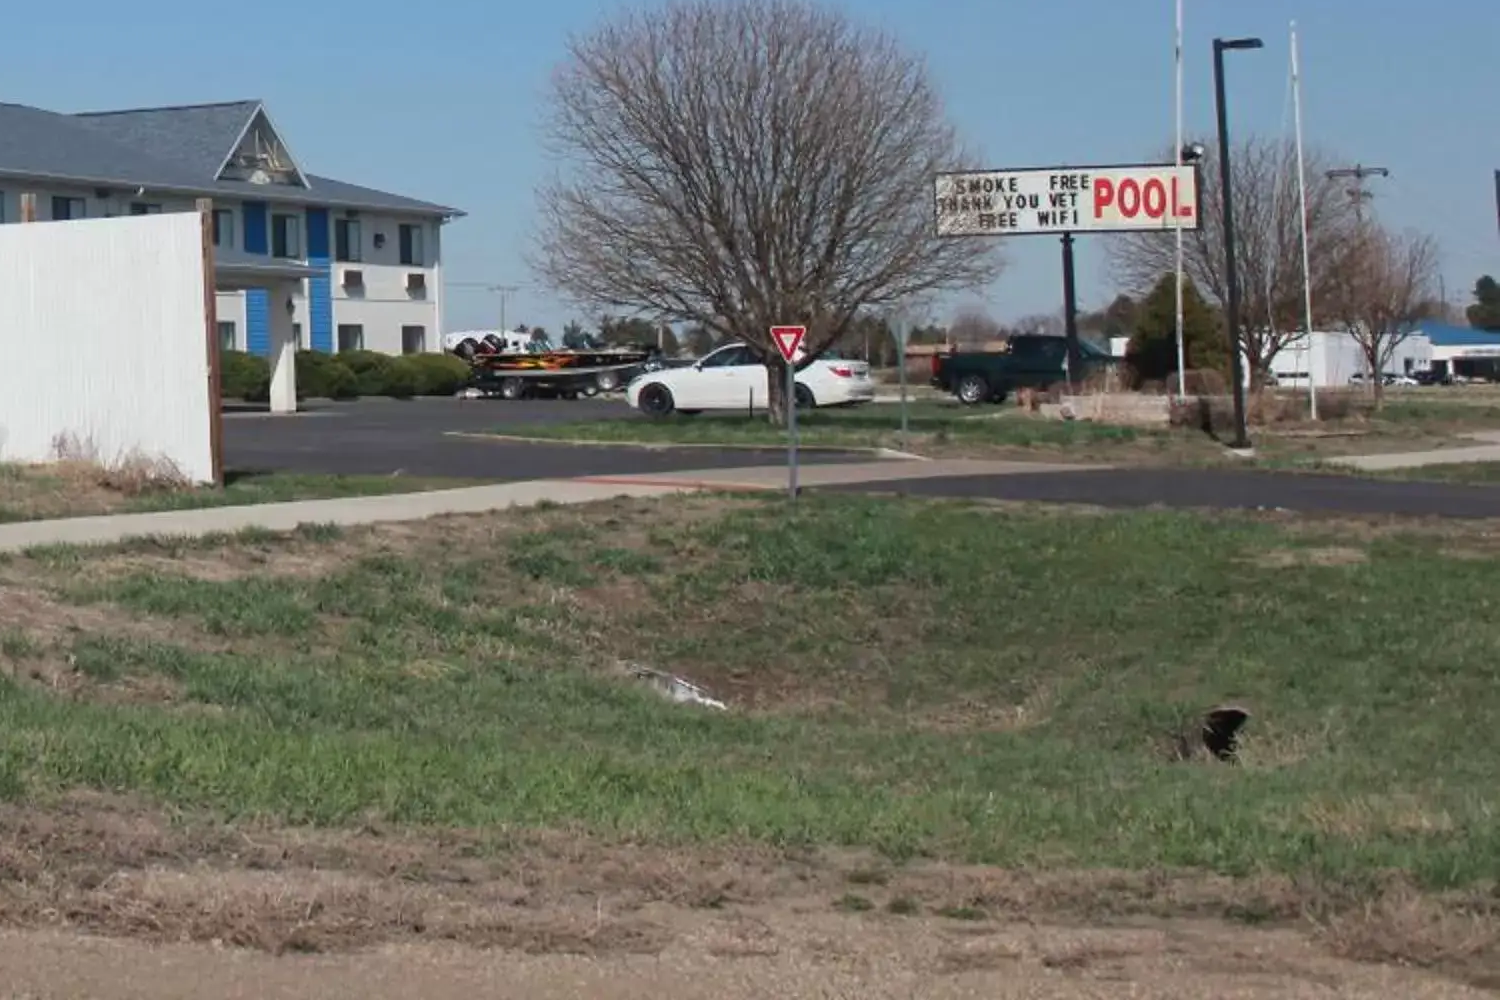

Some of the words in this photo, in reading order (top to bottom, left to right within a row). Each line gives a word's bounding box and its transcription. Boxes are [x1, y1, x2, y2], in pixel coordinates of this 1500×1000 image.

[955, 177, 1018, 194] SMOKE
[1050, 175, 1090, 190] FREE
[1004, 194, 1039, 209] YOU
[1049, 193, 1078, 207] VET
[1094, 176, 1192, 218] POOL
[979, 213, 1018, 228] FREE
[1038, 210, 1078, 226] WIFI
